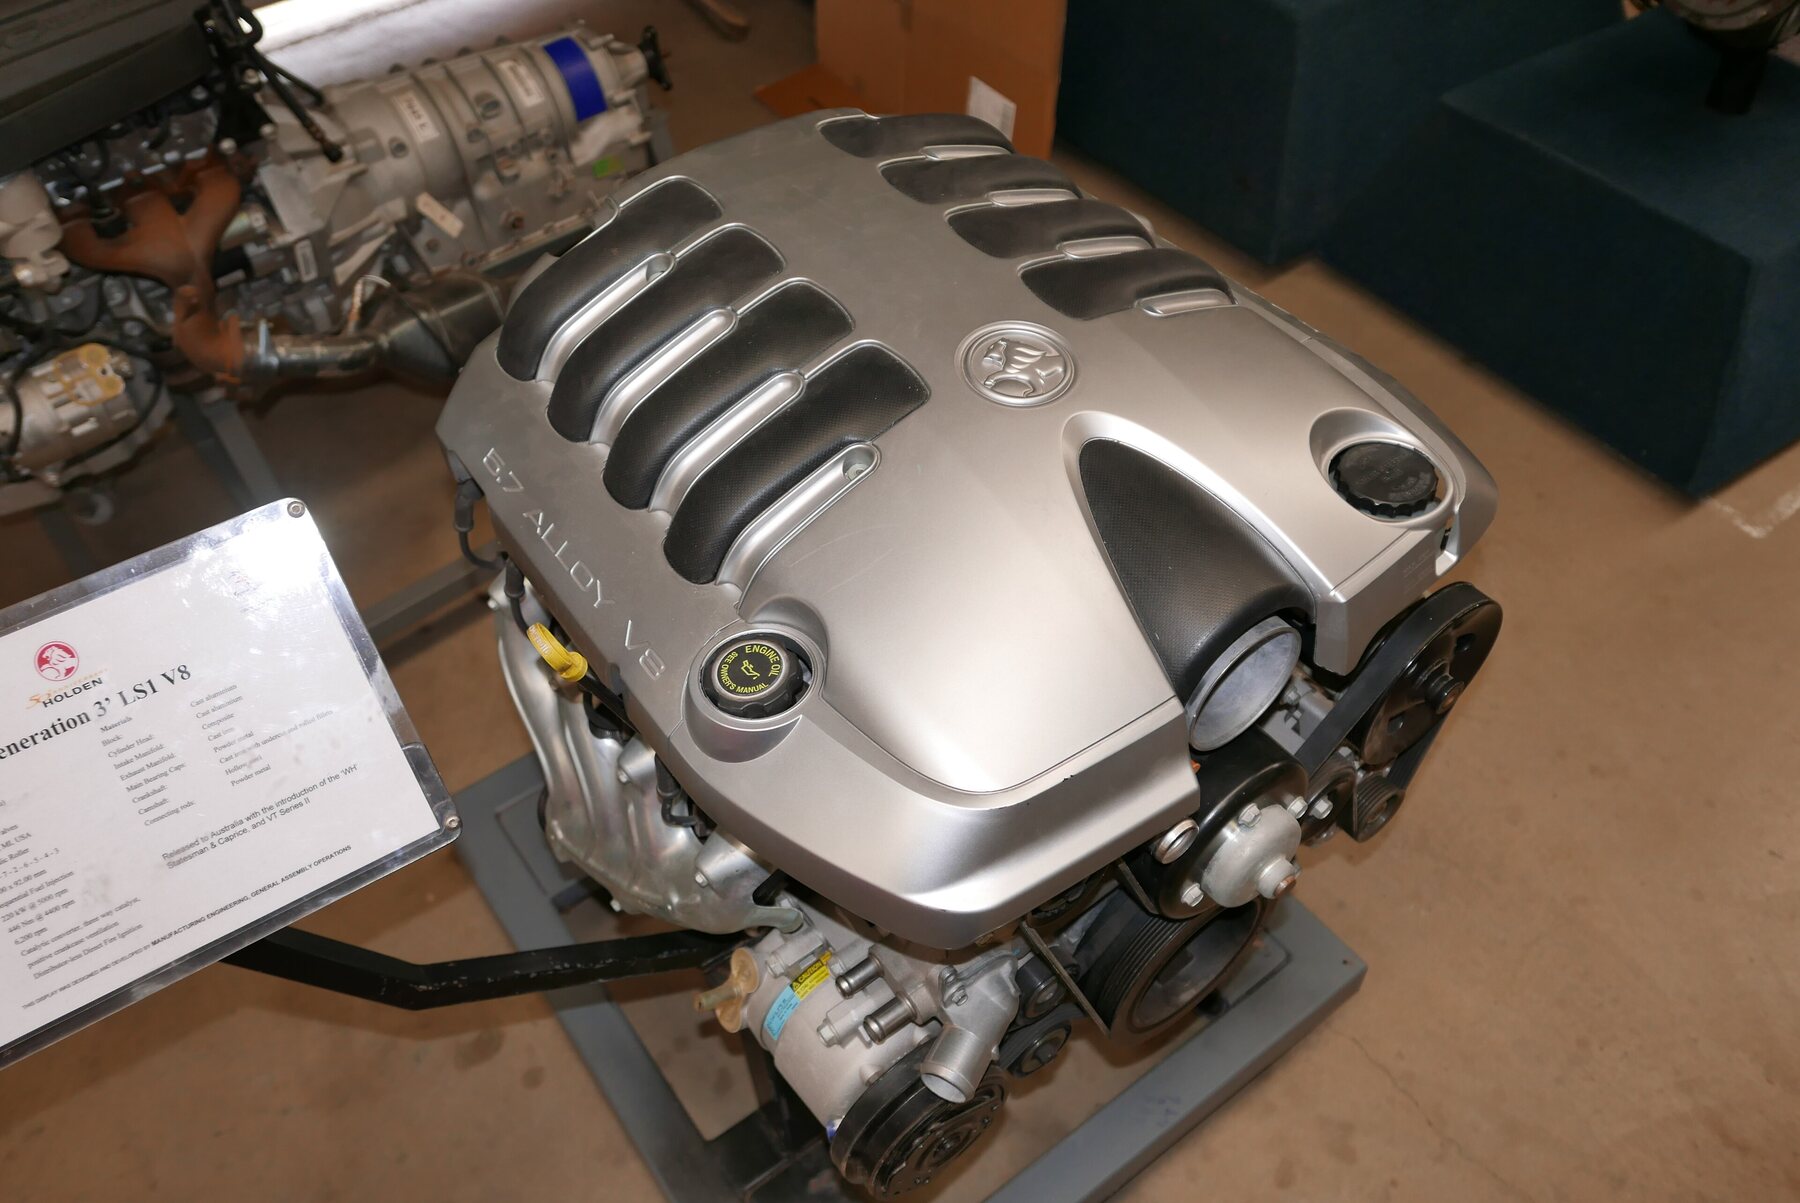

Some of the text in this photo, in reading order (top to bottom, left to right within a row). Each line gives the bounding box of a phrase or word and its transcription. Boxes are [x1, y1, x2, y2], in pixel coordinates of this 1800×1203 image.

[523, 508, 615, 608] ALLOY
[624, 619, 666, 680] V8
[745, 644, 781, 677] ENGINE OIL
[720, 651, 769, 694] SEE OWNER'S MANUAL
[42, 677, 103, 708] HOLDEN
[190, 698, 205, 707] Cast
[0, 710, 91, 760] eneration
[161, 664, 191, 686] V8
[196, 709, 211, 719] Cast
[202, 713, 234, 730] Composite
[100, 717, 132, 732] Materials
[207, 732, 222, 741] Cast
[108, 743, 135, 758] Cylinder
[219, 755, 234, 764] Cast
[113, 758, 134, 770] Intake
[120, 767, 146, 781] Exhaust
[126, 782, 144, 792] Main
[143, 771, 169, 784] Bearing
[230, 764, 271, 787] Powder metal
[144, 808, 180, 826] Connecting
[162, 839, 200, 860] Released
[200, 835, 210, 843] to
[211, 819, 244, 838] Australia
[244, 811, 261, 821] with
[261, 805, 274, 814] the
[275, 784, 318, 807] introduction
[319, 778, 327, 787] of
[327, 774, 340, 783] the
[166, 847, 209, 869] Statesman
[210, 841, 217, 849] &
[251, 818, 266, 829] and
[266, 811, 277, 821] VT
[279, 801, 304, 816] Series
[29, 883, 45, 895] Fuel
[45, 871, 74, 887] Injection
[33, 869, 47, 878] mm
[54, 888, 68, 898] rpm
[151, 917, 206, 946] MANUFACTURING
[251, 881, 280, 897] GENERAL
[281, 864, 312, 883] ASSEMBLY
[313, 845, 351, 866] OPERATIONS
[61, 899, 75, 909] rpm
[21, 940, 50, 956] Catalytic
[100, 910, 113, 918] way
[33, 927, 48, 936] rpm
[82, 943, 103, 956] Direct
[103, 936, 117, 946] Fire
[117, 924, 143, 939] Ignition
[27, 921, 119, 969] positive crankcase ventilation
[798, 960, 823, 982] CAUTION
